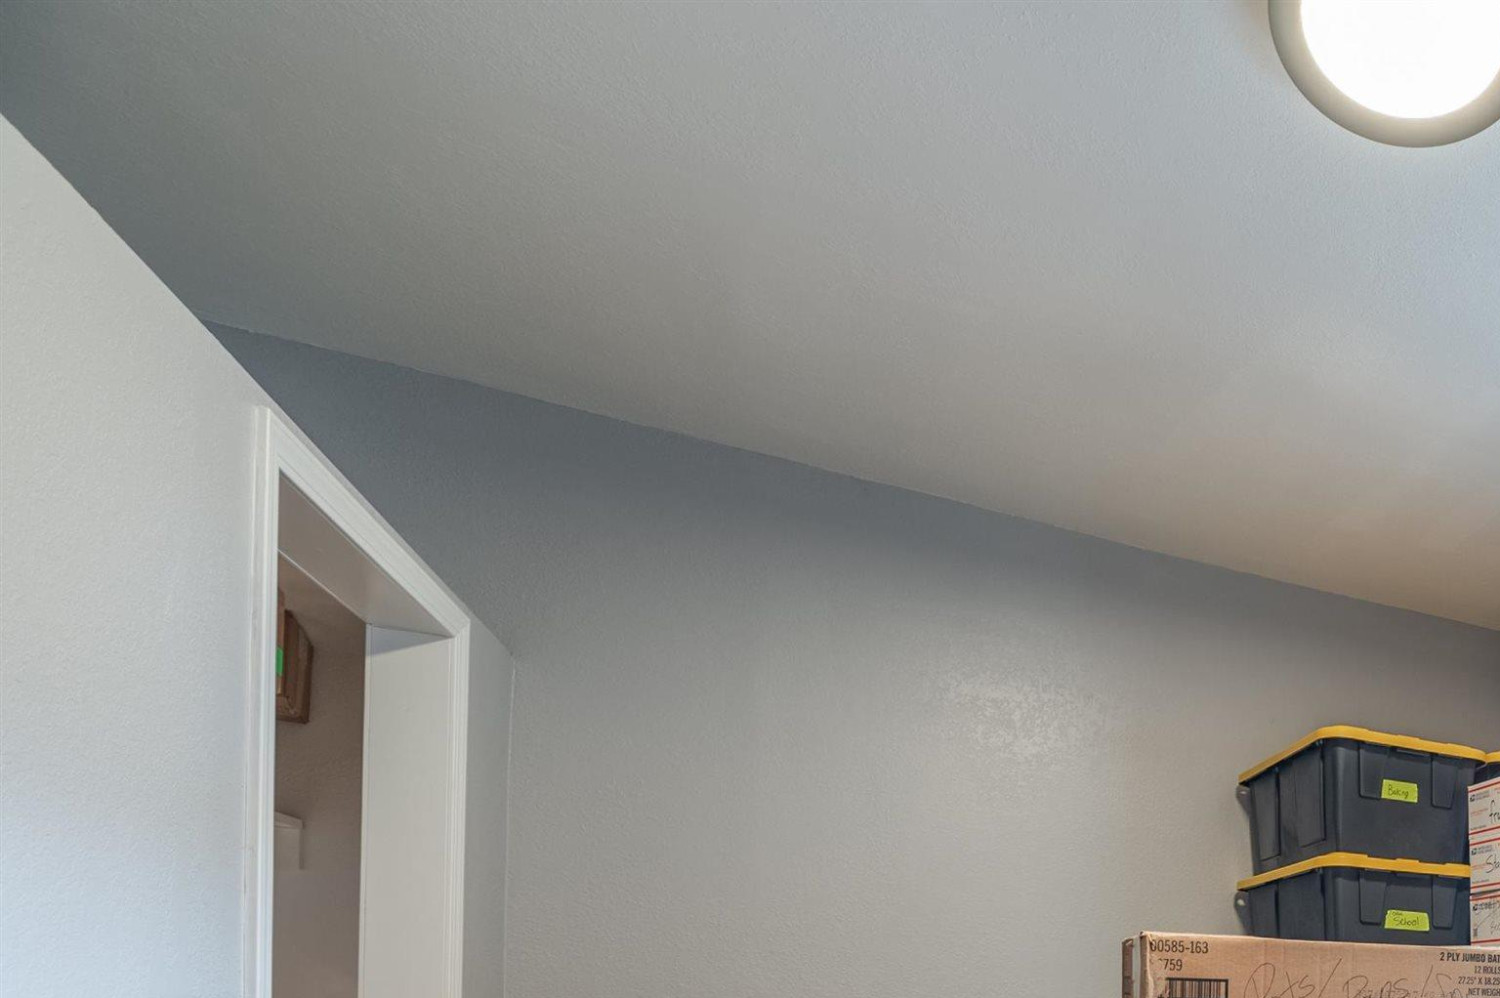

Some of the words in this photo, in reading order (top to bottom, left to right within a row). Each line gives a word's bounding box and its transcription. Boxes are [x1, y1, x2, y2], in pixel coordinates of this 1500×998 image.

[1440, 952, 1444, 961] 2
[1447, 952, 1460, 962] PLY
[1462, 953, 1486, 963] JUMBO
